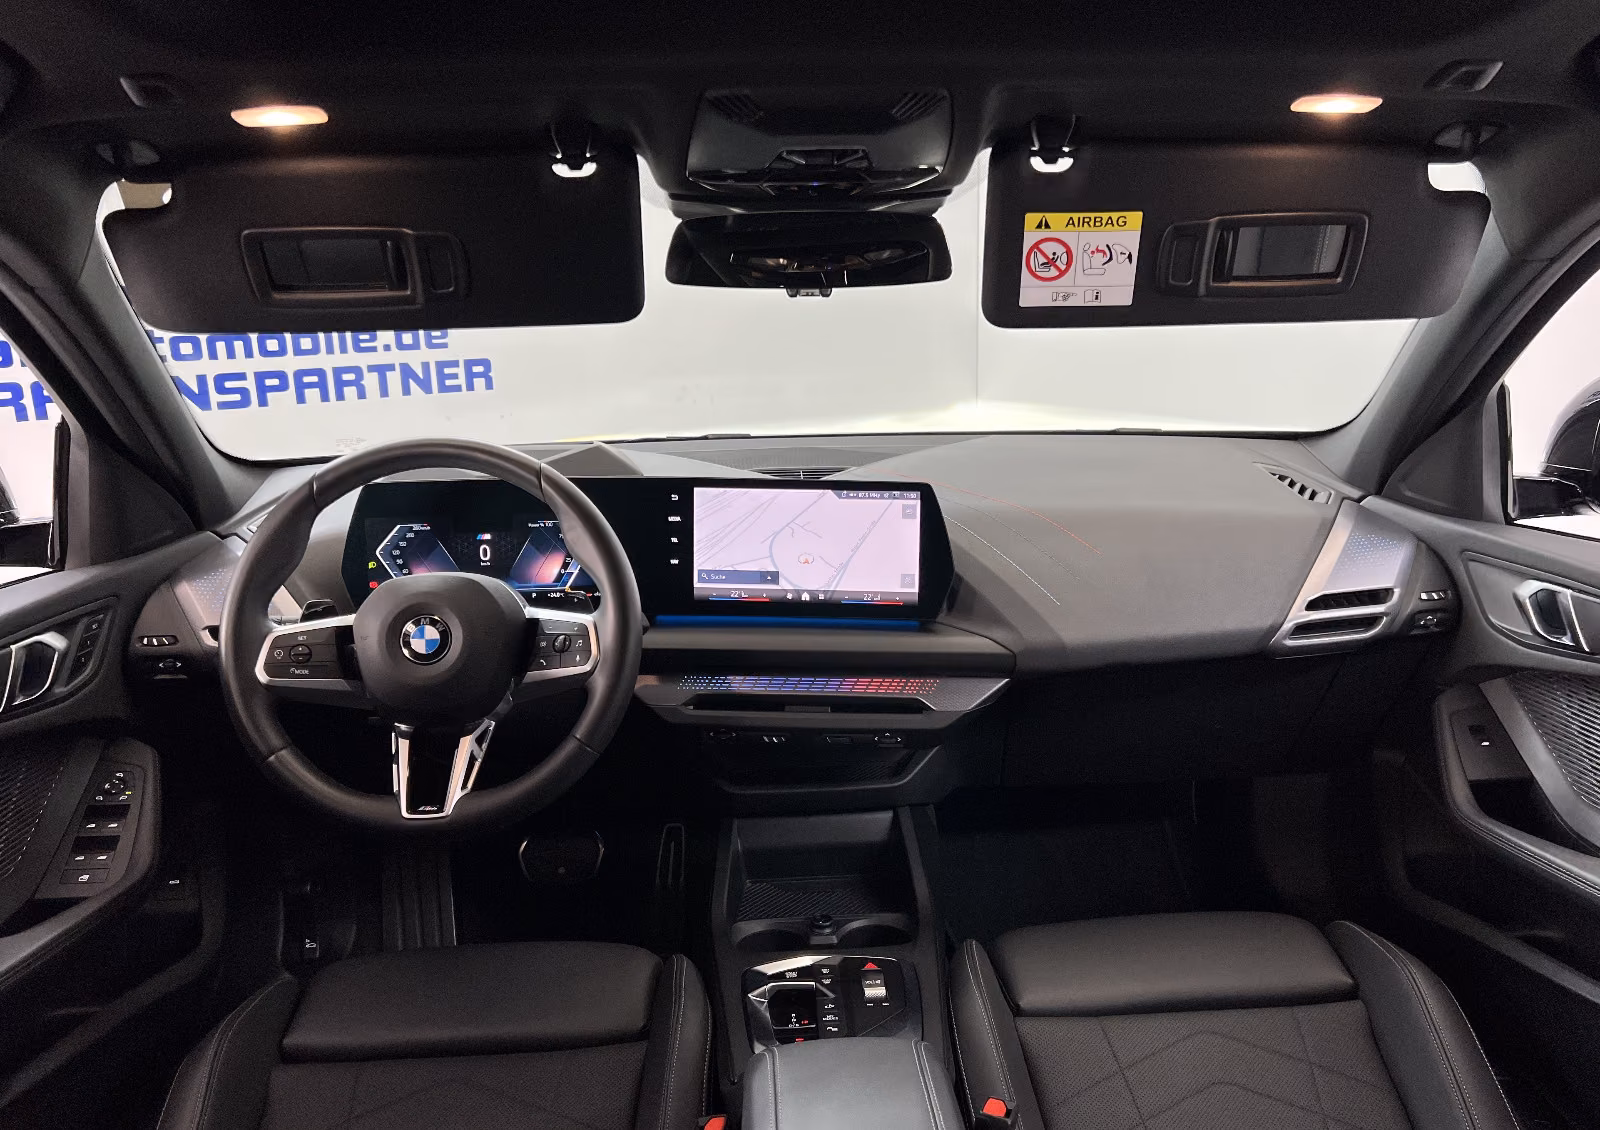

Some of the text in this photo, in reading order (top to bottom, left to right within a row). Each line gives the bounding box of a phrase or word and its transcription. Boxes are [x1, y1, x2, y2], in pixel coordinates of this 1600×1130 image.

[1065, 215, 1128, 228] AIRBAG
[171, 358, 494, 411] NSPARTNER
[480, 544, 491, 561] 0
[405, 617, 446, 633] BMW
